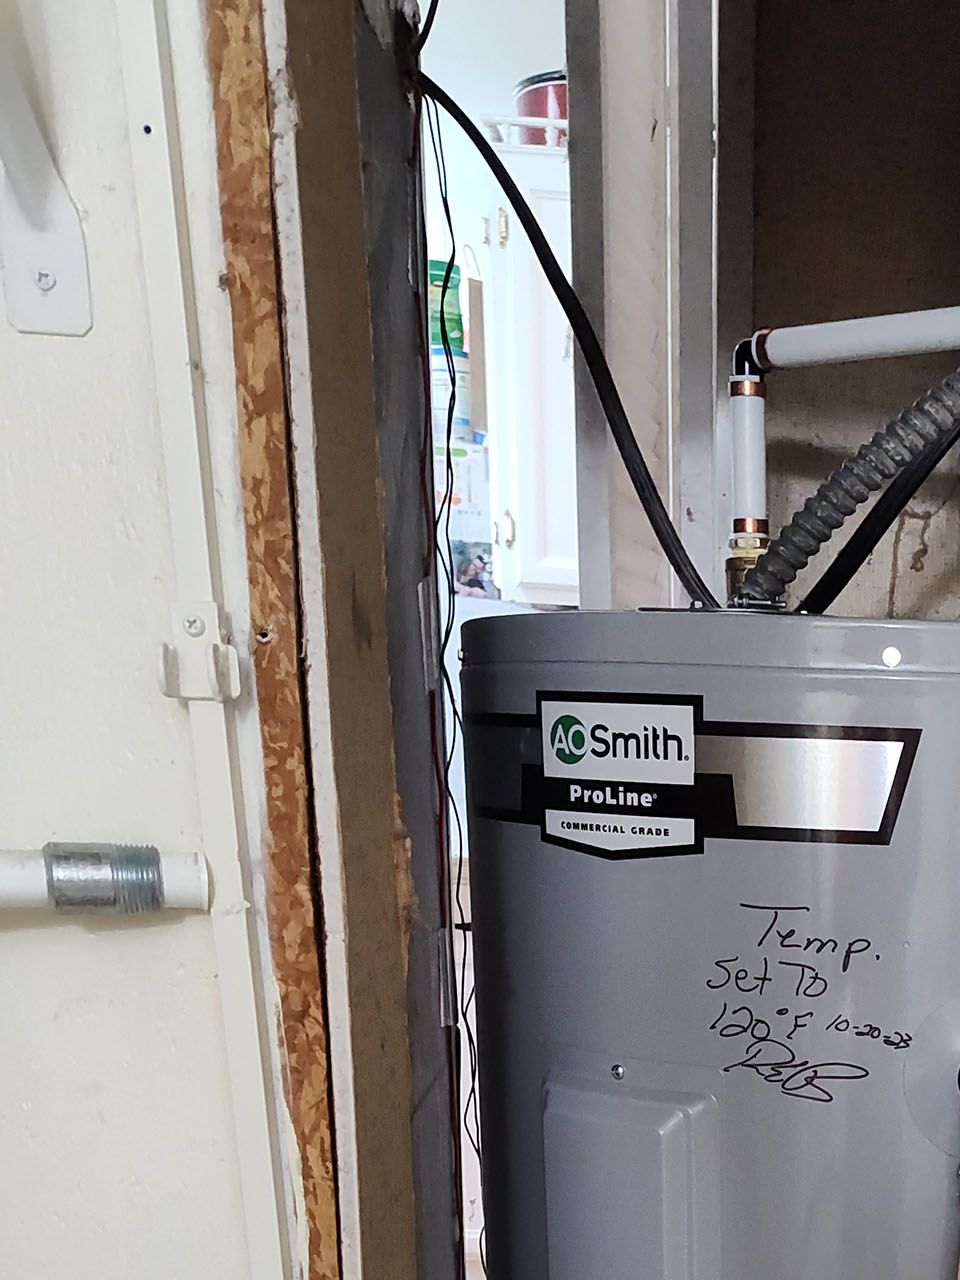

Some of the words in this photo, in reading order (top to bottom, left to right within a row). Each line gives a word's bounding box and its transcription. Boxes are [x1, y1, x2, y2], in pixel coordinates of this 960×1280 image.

[569, 784, 653, 807] ProLine
[560, 820, 626, 834] COMMERCIAL
[630, 826, 670, 837] GRADE
[740, 903, 880, 973] Temp.
[706, 956, 772, 995] Set
[778, 960, 828, 997] To
[826, 1014, 913, 1049] 10-20-23
